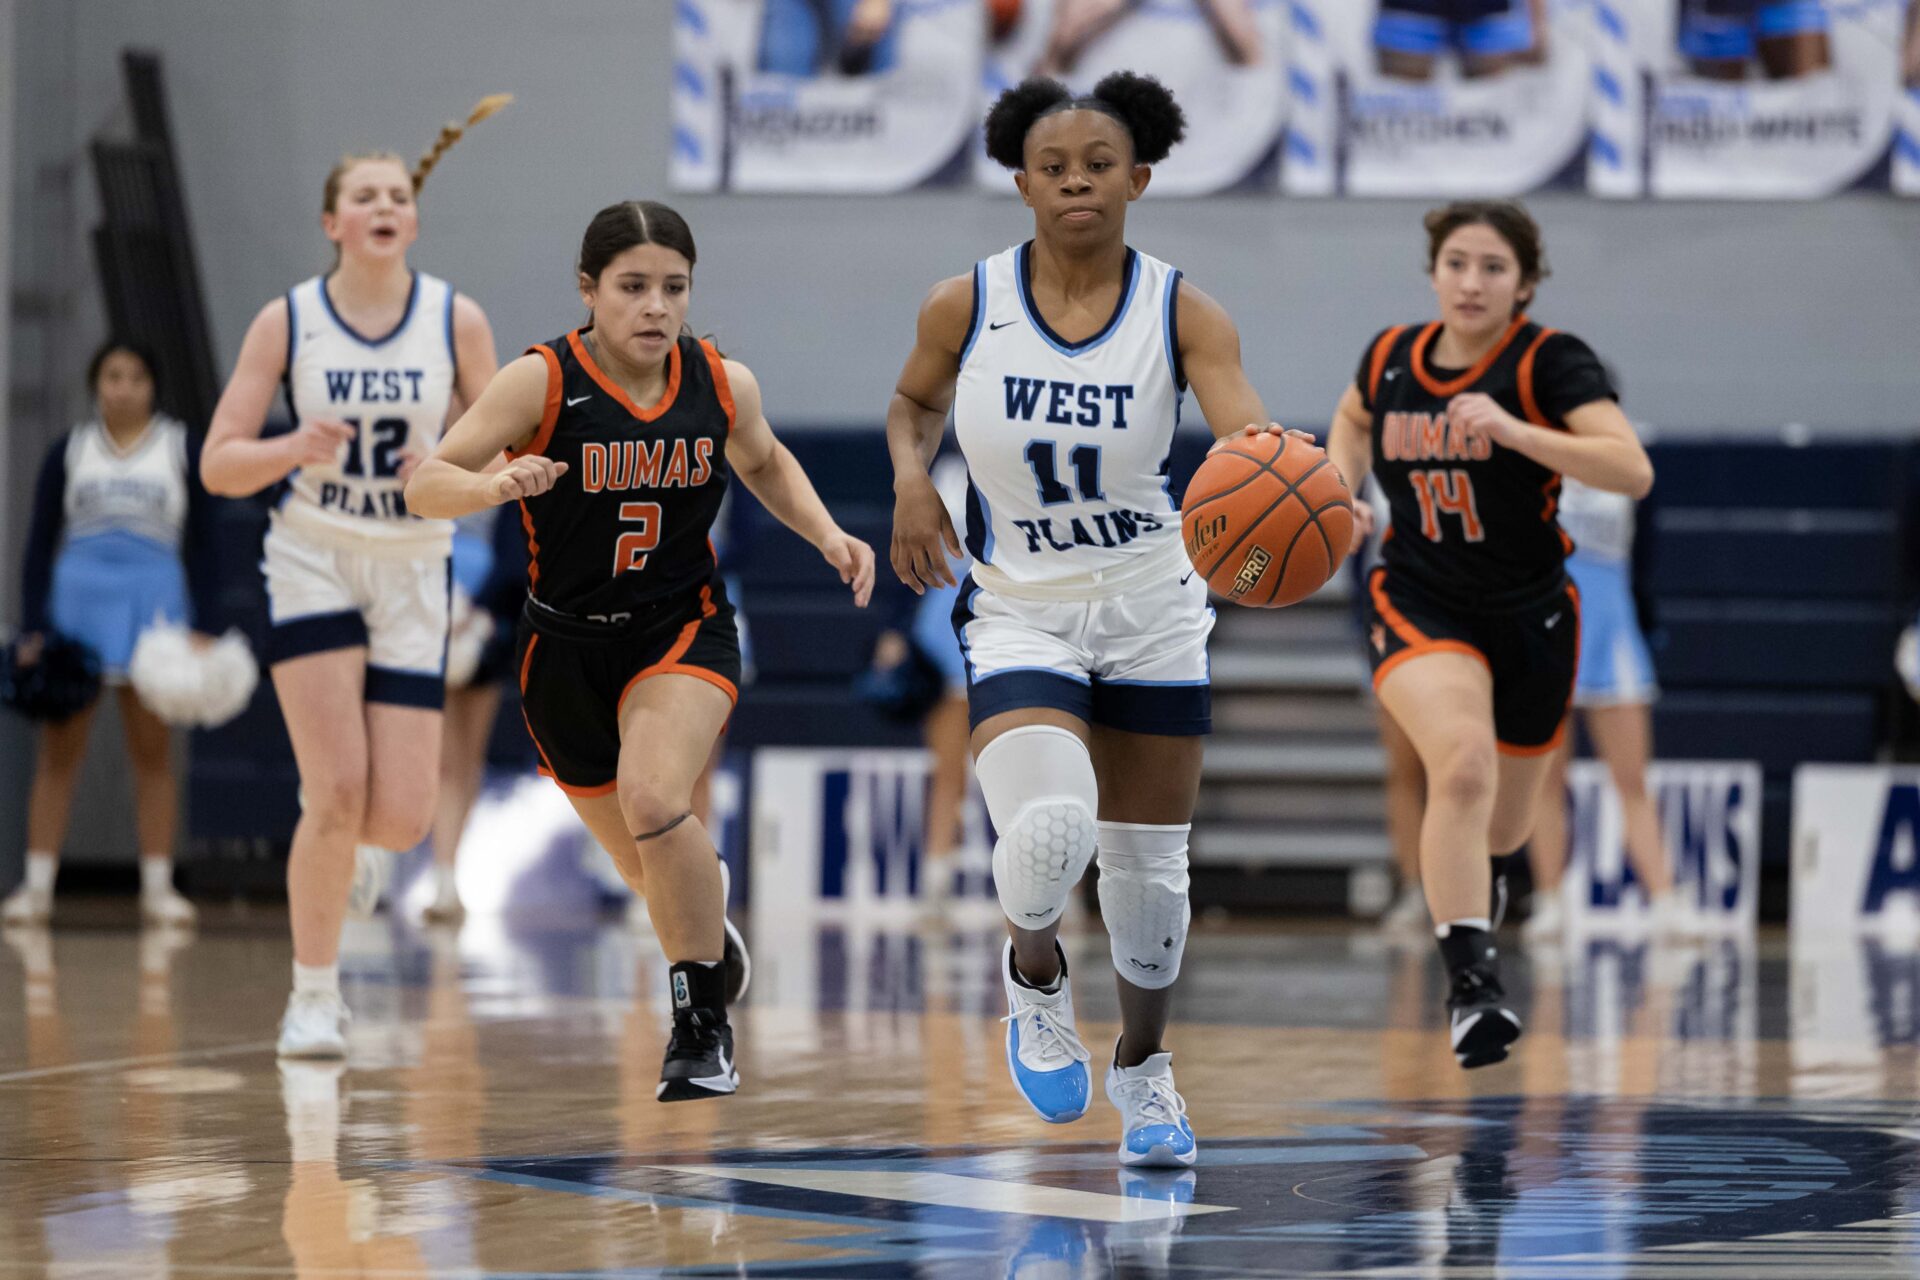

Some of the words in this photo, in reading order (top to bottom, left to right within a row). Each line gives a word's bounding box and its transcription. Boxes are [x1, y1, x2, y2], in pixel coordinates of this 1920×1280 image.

[326, 370, 424, 402] WEST
[1003, 375, 1134, 429] WEST
[342, 416, 410, 478] 12
[582, 437, 713, 493] DUMAS
[1023, 438, 1107, 508] 11
[1012, 508, 1163, 553] PLAINS
[1408, 469, 1485, 543] 14
[612, 501, 662, 578] 2
